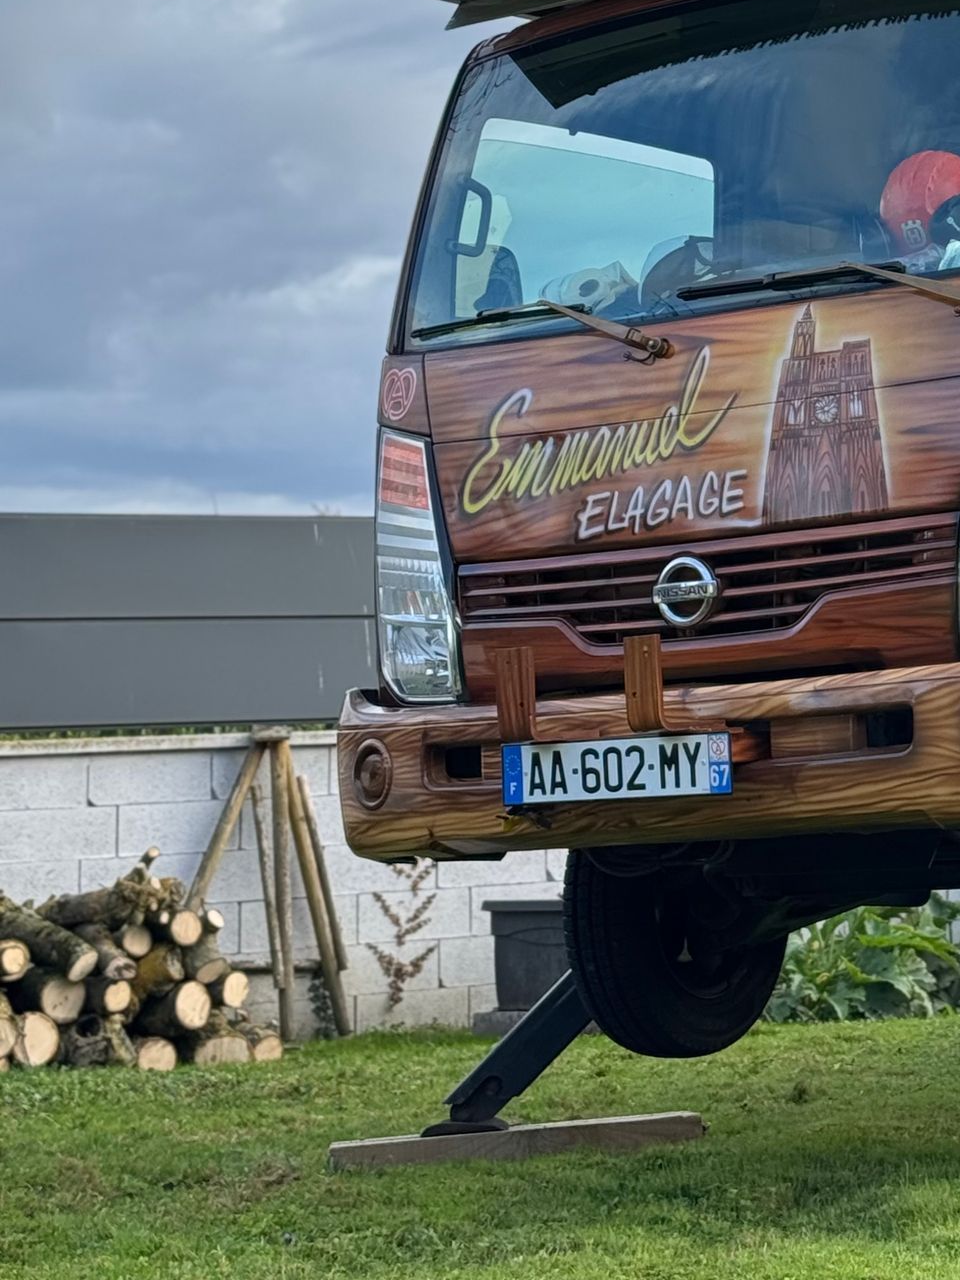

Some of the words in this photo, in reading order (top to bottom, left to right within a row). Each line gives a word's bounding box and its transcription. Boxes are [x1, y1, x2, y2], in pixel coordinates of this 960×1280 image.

[462, 344, 738, 515] Emmanuel
[576, 469, 748, 541] ELAGAGE
[656, 584, 709, 598] NISSAN
[509, 782, 517, 796] F
[710, 764, 730, 788] 67
